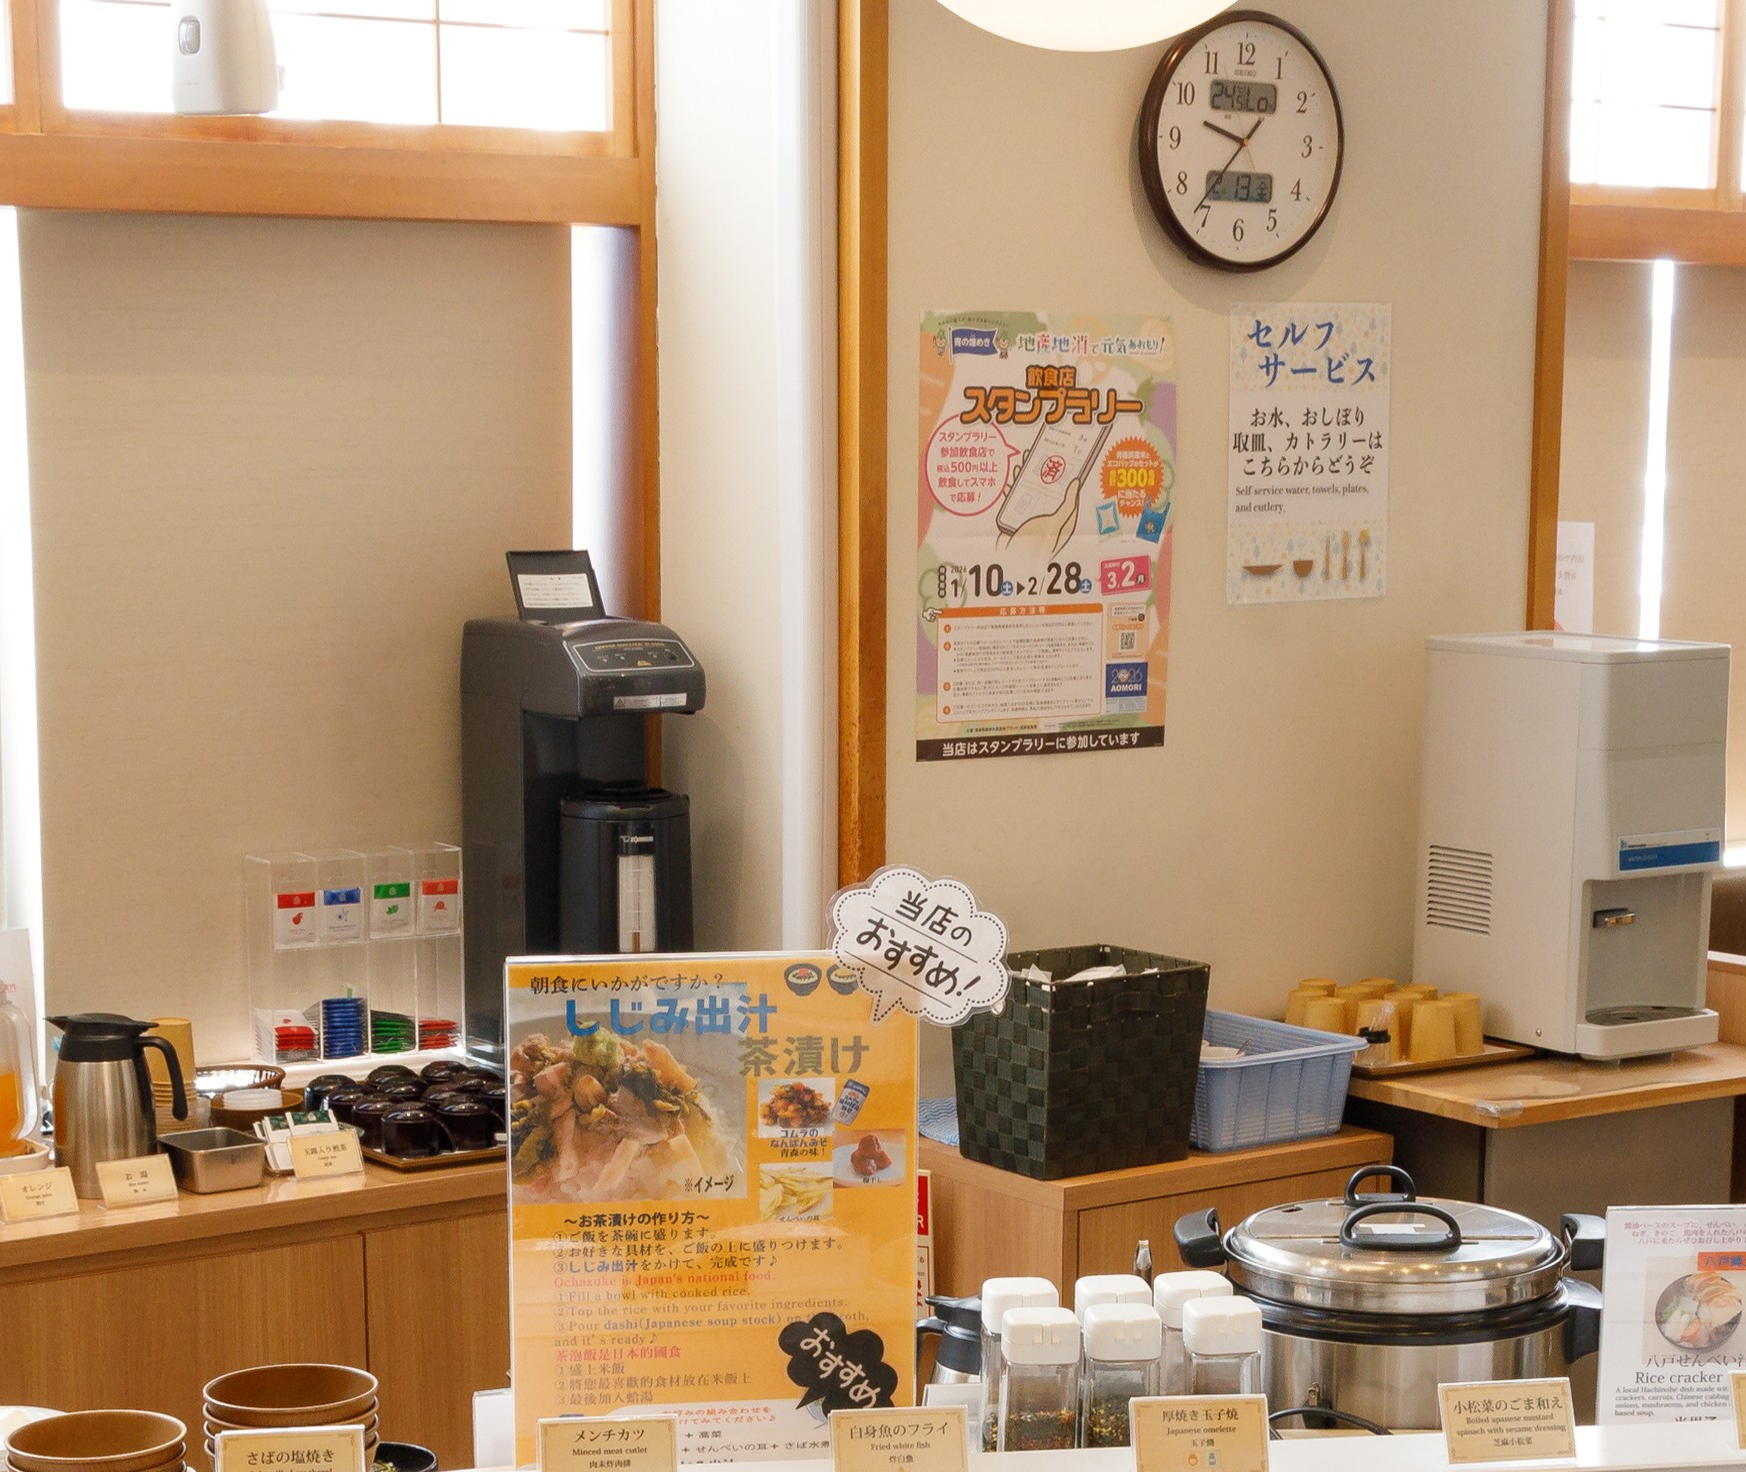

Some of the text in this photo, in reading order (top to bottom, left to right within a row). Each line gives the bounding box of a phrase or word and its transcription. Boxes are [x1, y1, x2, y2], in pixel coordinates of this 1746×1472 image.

[1205, 51, 1219, 75] 11
[1238, 42, 1256, 66] 12
[1276, 57, 1283, 80] 1
[1177, 82, 1195, 106] 10
[1296, 91, 1308, 114] 2
[1169, 126, 1181, 150] 9
[1301, 135, 1313, 158] 3
[1176, 171, 1188, 195] 8
[1290, 178, 1302, 201] 4
[1199, 205, 1211, 229] 7
[1266, 209, 1277, 232] 5
[1232, 219, 1244, 242] 6
[1247, 319, 1335, 351] セルフ
[1026, 365, 1077, 389] 飲食店
[1258, 353, 1376, 388] サービス
[960, 386, 1144, 425] スタンプラリー
[1250, 406, 1365, 429] お水、おしぼり
[939, 431, 997, 443] スタンプラリー
[1233, 432, 1384, 453] 取皿、カトラリーは
[940, 446, 996, 459] 参加飲食店で
[936, 461, 998, 473] 税込500円以上
[1043, 458, 1063, 480] 済
[1242, 455, 1375, 477] こちらからどうぞ
[938, 476, 997, 488] 飲食してスマホ
[1236, 485, 1253, 496] Self
[1254, 486, 1283, 496] service
[1285, 486, 1311, 497] water,
[1235, 502, 1252, 513] and
[1111, 684, 1142, 692] AOMORI
[942, 731, 1140, 757] 当店はスタンプラリーに参加しています
[896, 889, 973, 947] 当店の
[856, 917, 982, 998] おすすめ!
[530, 972, 723, 995] 朝食にいかがですか？
[566, 994, 778, 1037] しじみ出汁
[737, 1034, 869, 1078] 茶漬け
[780, 1128, 819, 1138] コムラの
[22, 1182, 52, 1193] オレンジ
[779, 1214, 820, 1222] せんべいの耳
[555, 1270, 775, 1289] Ochazuke is Japan's national food.
[595, 1285, 750, 1301] a bowl with cooked rice.
[598, 1297, 848, 1315] the rice with your favorite ingredients.
[707, 1317, 737, 1328] soup
[555, 1333, 646, 1347] and ready
[556, 1345, 682, 1362] 茶泡飯是日本的國食
[800, 1327, 881, 1409] おすすめ
[1636, 1370, 1724, 1384] Rice cracker
[1679, 1385, 1695, 1393] dish
[1705, 1392, 1730, 1401] cabbag
[1454, 1396, 1563, 1415] 小松菜のごま和え
[1686, 1400, 1699, 1408] and
[1700, 1400, 1727, 1408] chicken
[1162, 1407, 1239, 1422] 厚焼き玉子焼
[1466, 1413, 1555, 1425] Boiled apanese mustard
[574, 1428, 645, 1443] メンチカツ
[849, 1422, 948, 1440] 白身魚のフライ
[1167, 1425, 1236, 1437] Japanese omelette
[1457, 1424, 1567, 1438] spinach with sesame dressing
[572, 1446, 647, 1457] Minced meat cutlet
[871, 1440, 931, 1451] Fried white fish
[247, 1448, 335, 1467] さばの塩焼き
